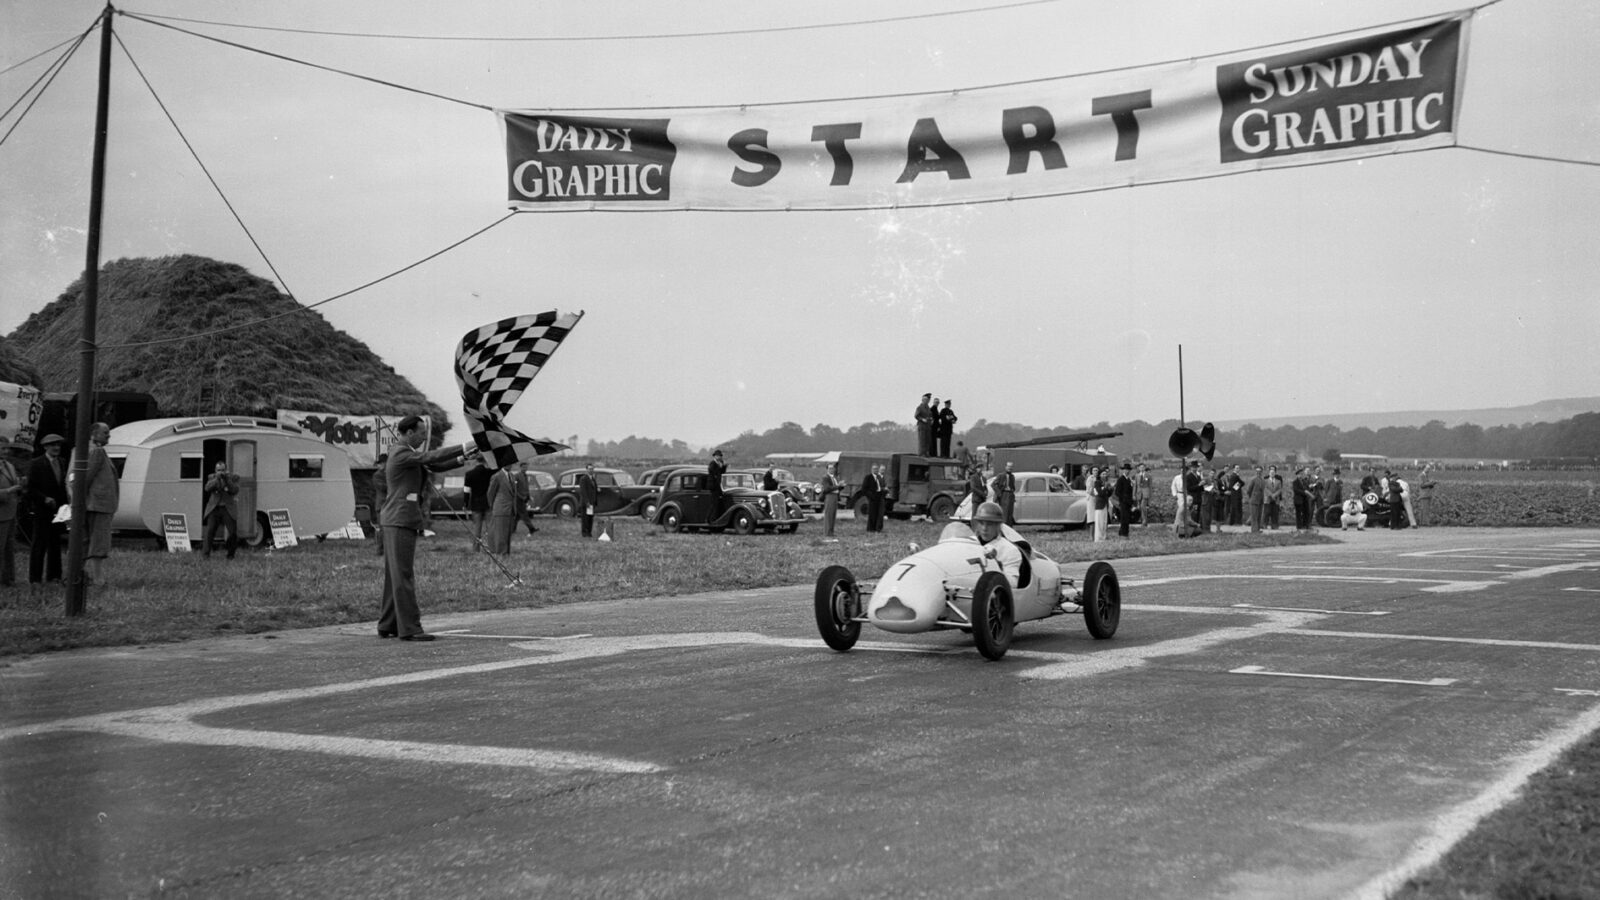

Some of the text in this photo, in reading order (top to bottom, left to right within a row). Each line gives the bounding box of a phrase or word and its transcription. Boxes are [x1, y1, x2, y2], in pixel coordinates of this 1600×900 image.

[1244, 39, 1432, 104] SUNDAY
[536, 119, 633, 152] DAILY
[731, 88, 1152, 187] START
[1232, 92, 1444, 154] GRAPHIC
[512, 159, 663, 198] GRAPHIC
[306, 415, 371, 444] Motor
[897, 563, 916, 581] 7
